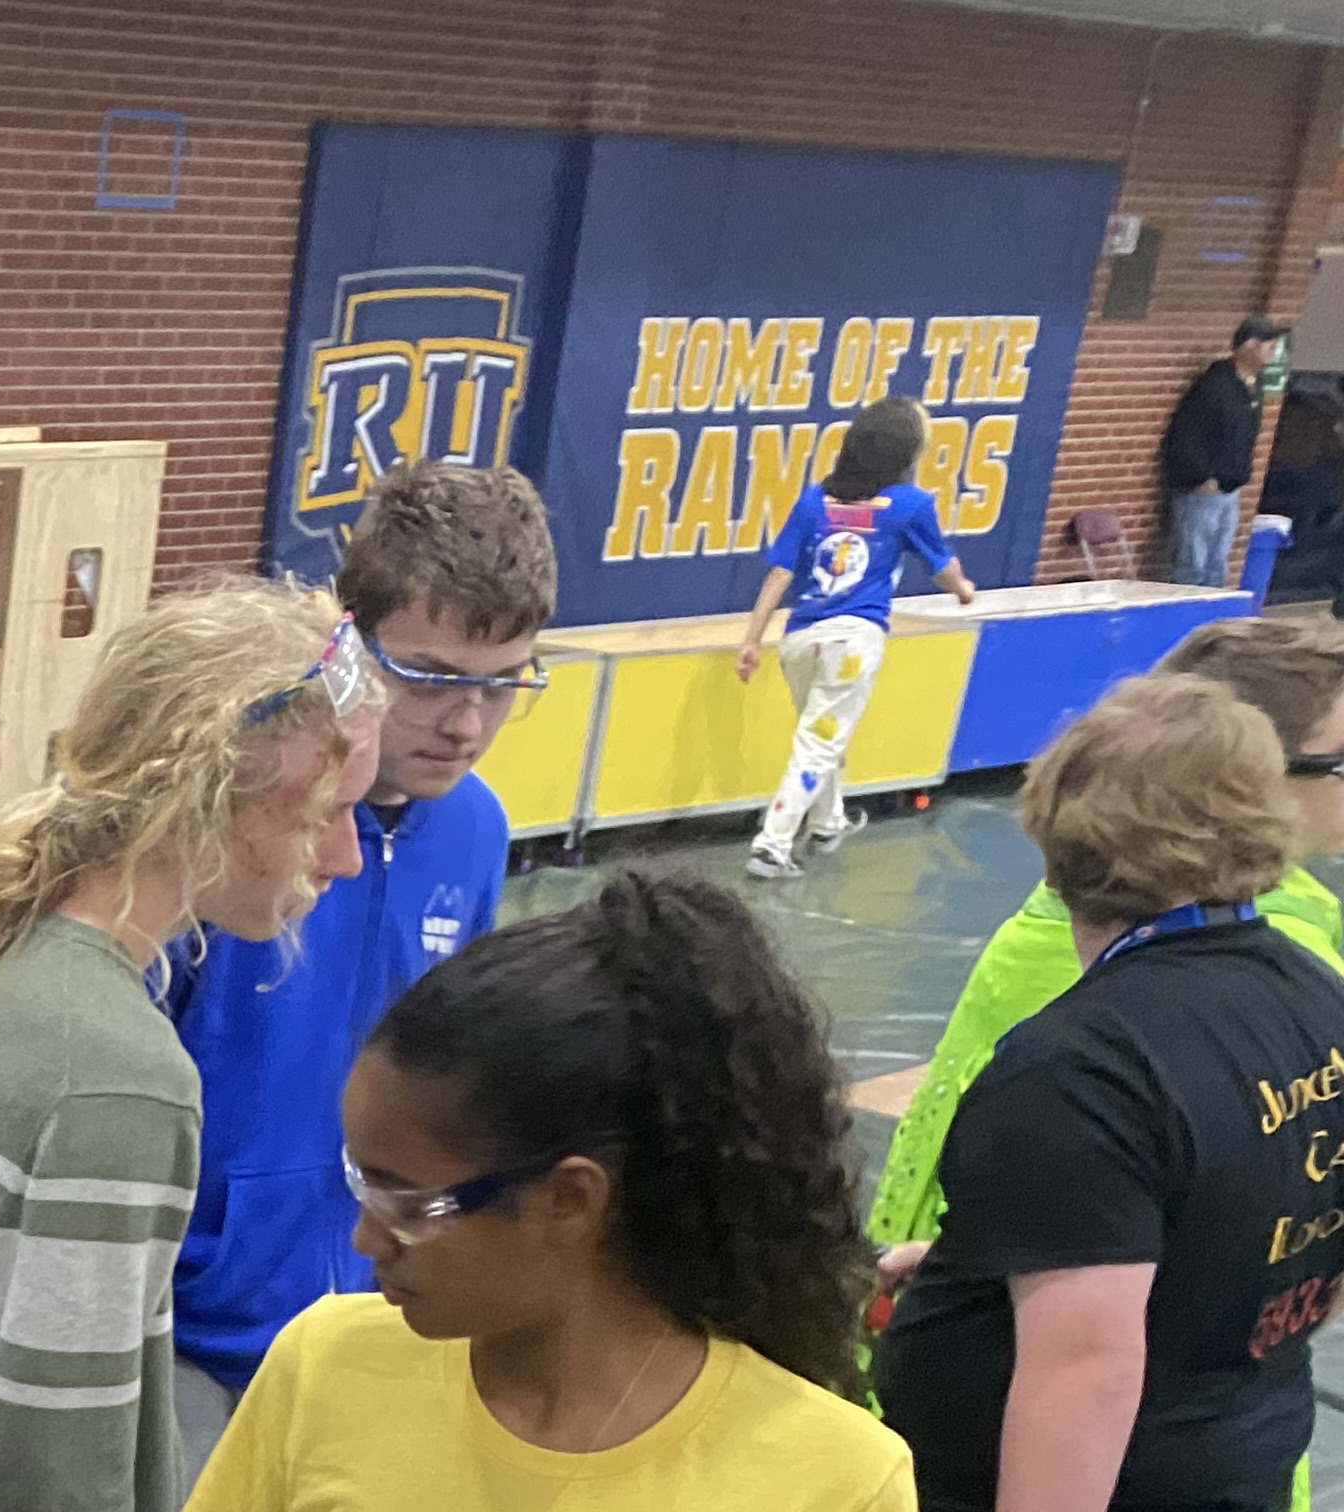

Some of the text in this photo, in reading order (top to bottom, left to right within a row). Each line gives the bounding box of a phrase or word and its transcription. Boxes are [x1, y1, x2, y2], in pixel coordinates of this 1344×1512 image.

[304, 346, 520, 504] RU
[626, 315, 1041, 414] HOME OF THE
[602, 414, 1018, 561] RANRS
